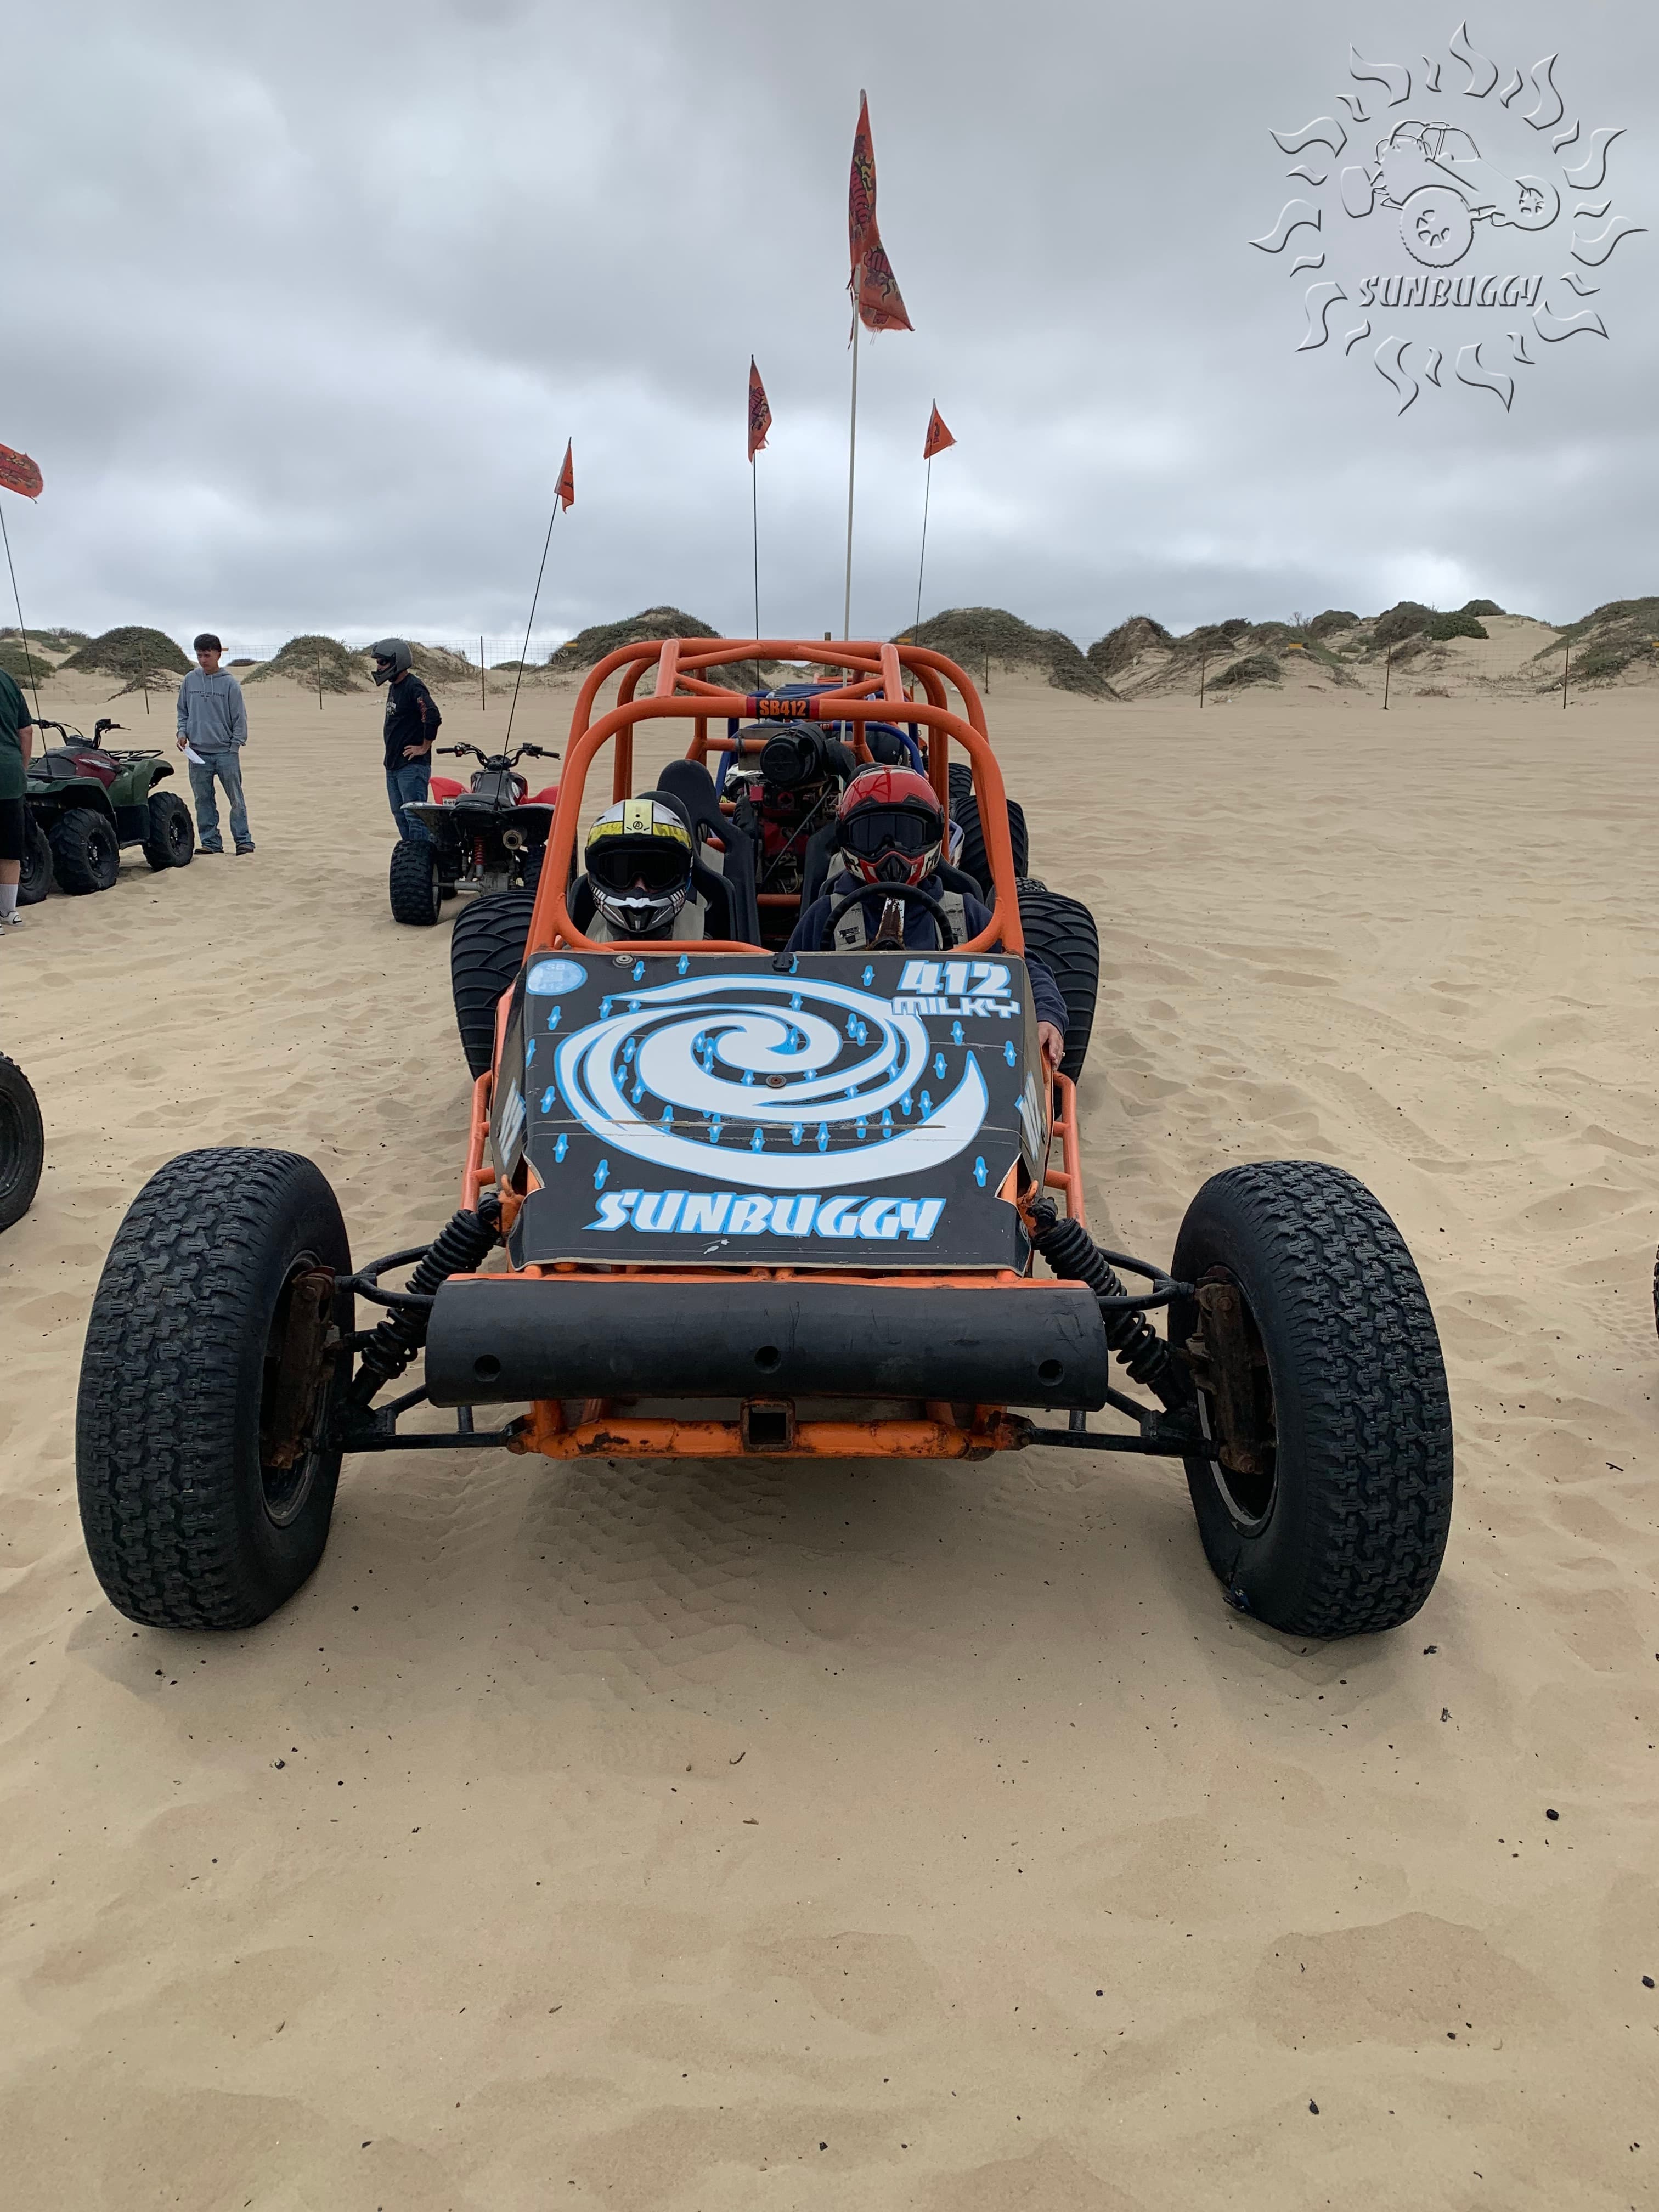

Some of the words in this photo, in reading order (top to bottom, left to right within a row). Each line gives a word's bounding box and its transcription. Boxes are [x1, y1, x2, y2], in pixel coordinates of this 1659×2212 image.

[759, 700, 806, 716] SB412
[897, 960, 1012, 998] 412
[892, 996, 1020, 1019] MILKY
[582, 1189, 947, 1241] SUNBUGGY
